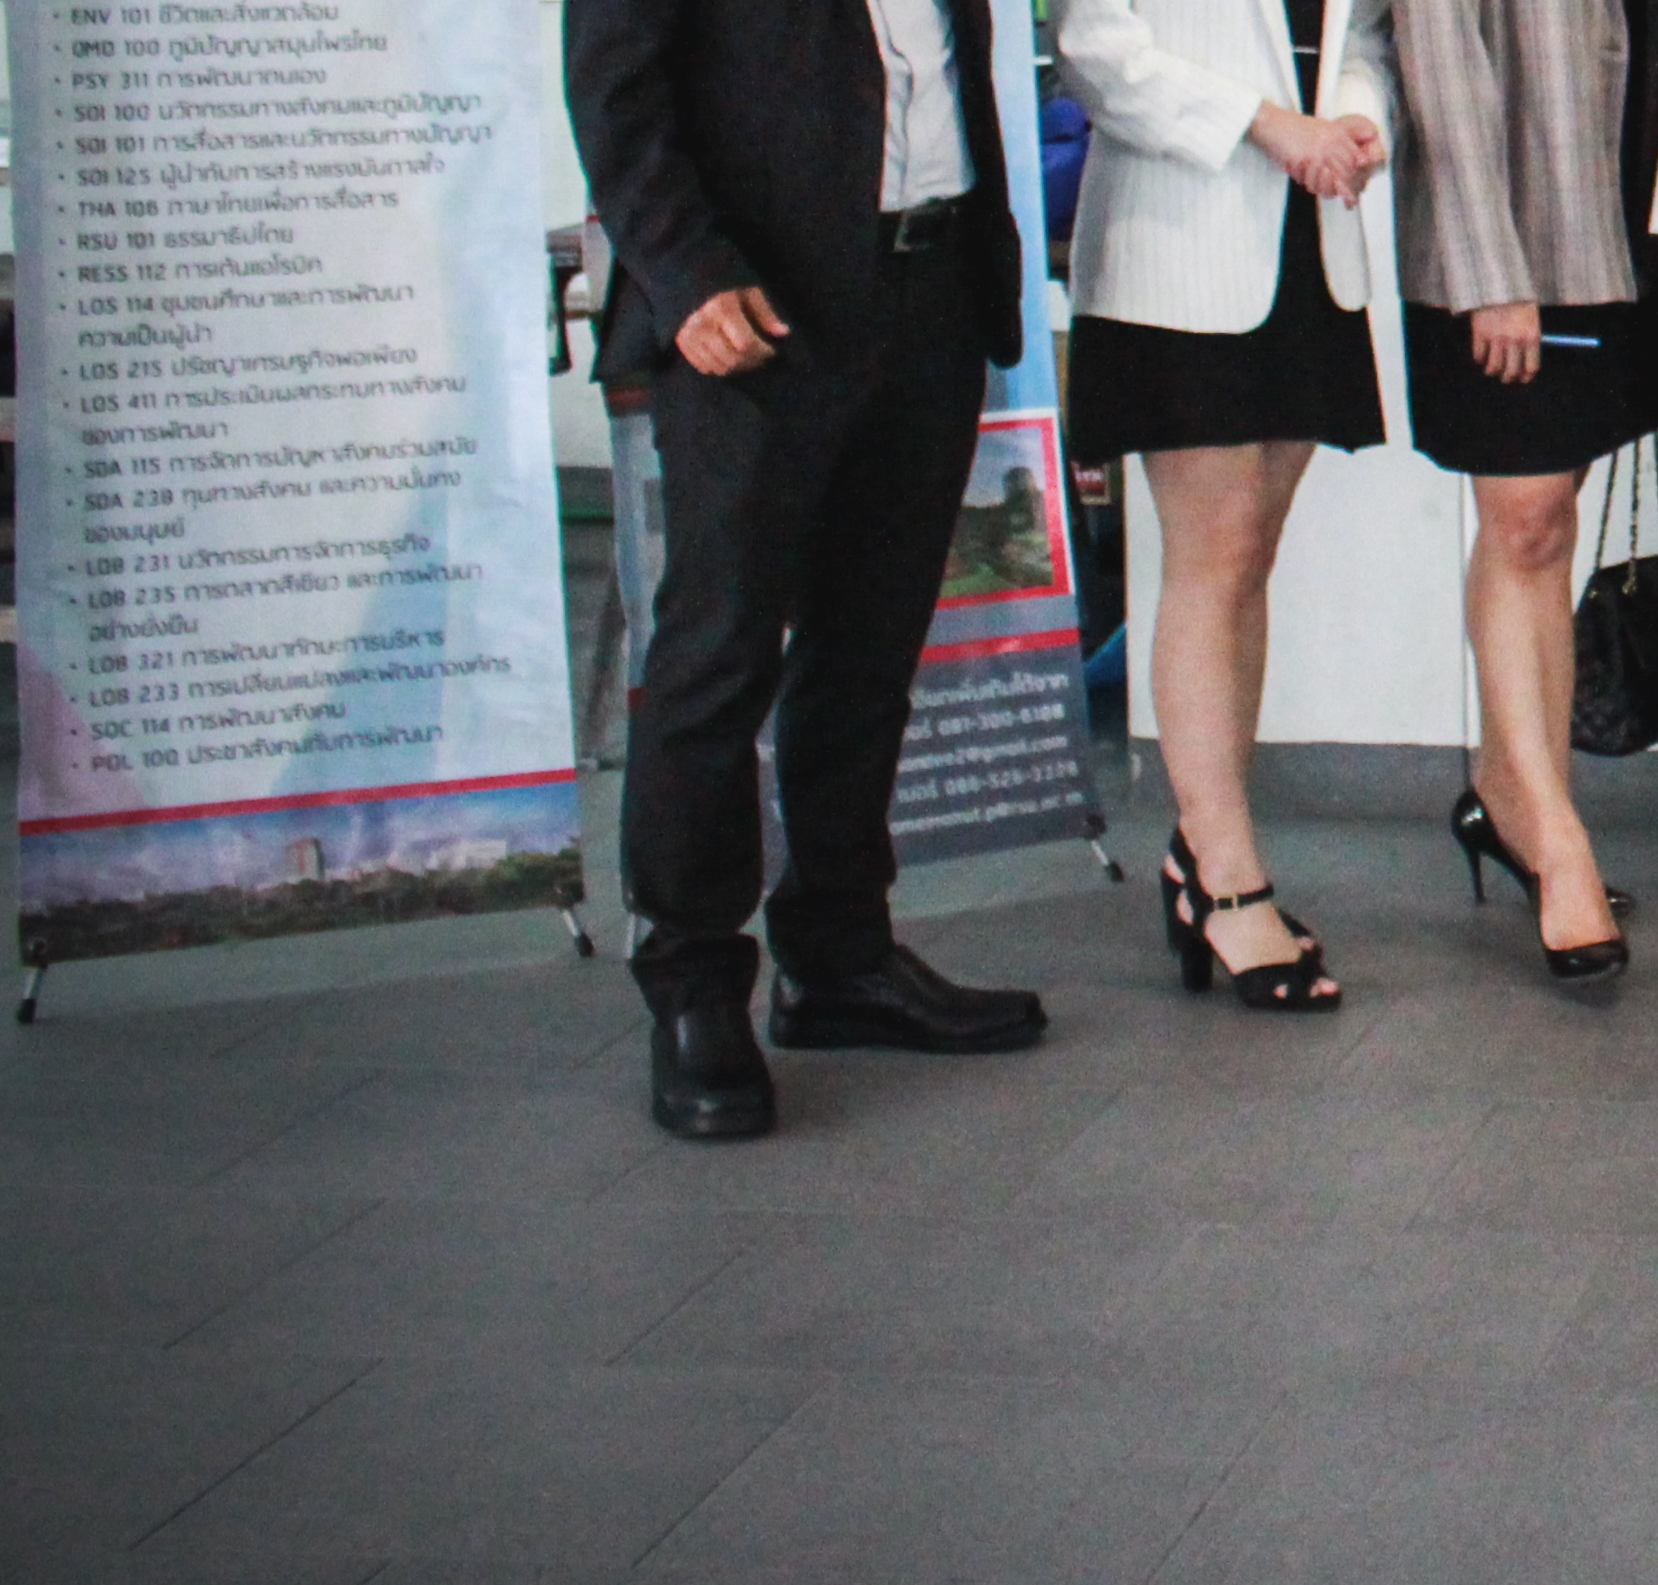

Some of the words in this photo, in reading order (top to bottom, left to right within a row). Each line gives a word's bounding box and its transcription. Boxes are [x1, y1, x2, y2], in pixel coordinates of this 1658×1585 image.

[71, 7, 112, 25] ENV
[120, 6, 151, 25] 101
[124, 38, 160, 57] 100
[71, 72, 110, 90] PSY
[113, 103, 151, 122] 100
[115, 135, 146, 154] 101
[76, 232, 118, 252] RSU
[126, 232, 156, 250] 101
[136, 262, 167, 281] 112
[141, 747, 179, 769] 100
